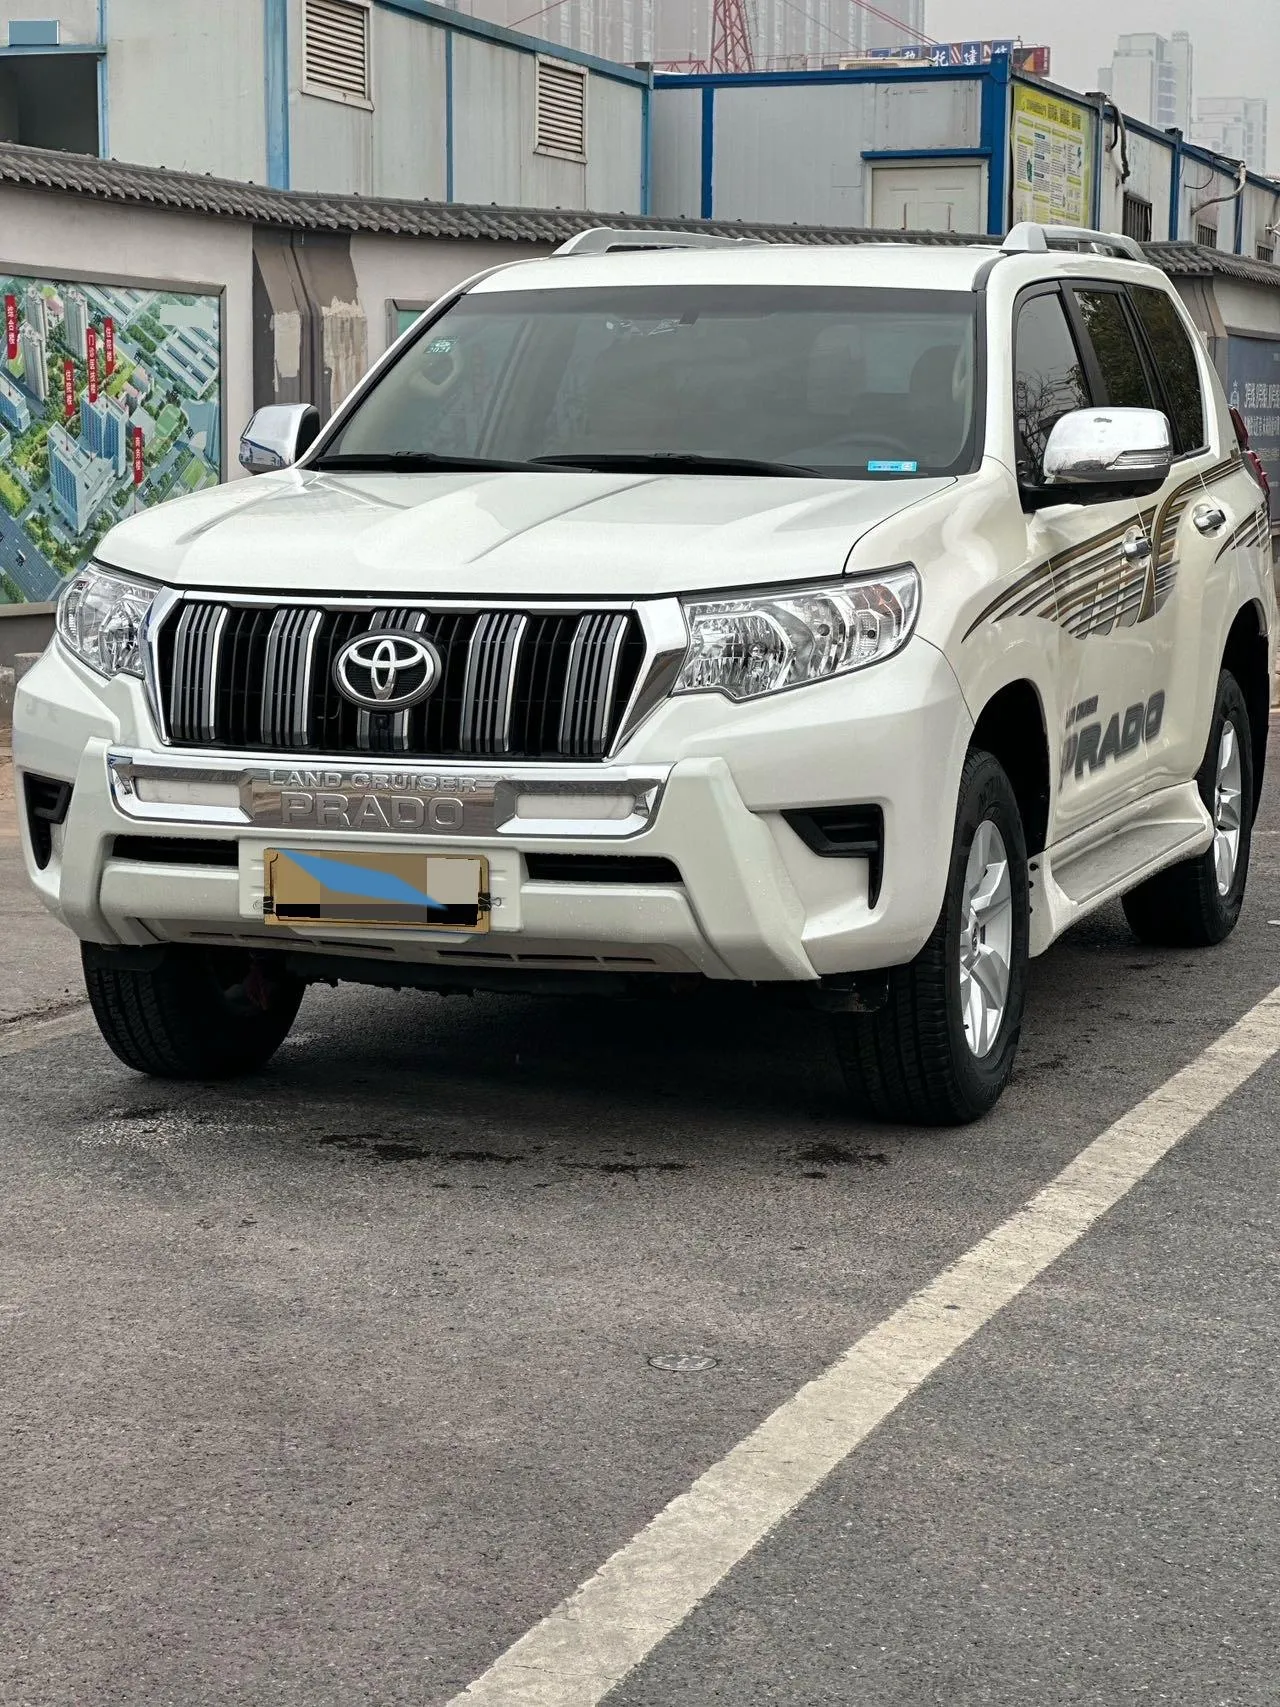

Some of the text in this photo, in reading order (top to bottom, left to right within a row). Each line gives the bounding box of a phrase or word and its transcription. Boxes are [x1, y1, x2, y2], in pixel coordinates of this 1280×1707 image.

[269, 770, 477, 792] LAND CRUISER
[280, 791, 465, 831] PRADO
